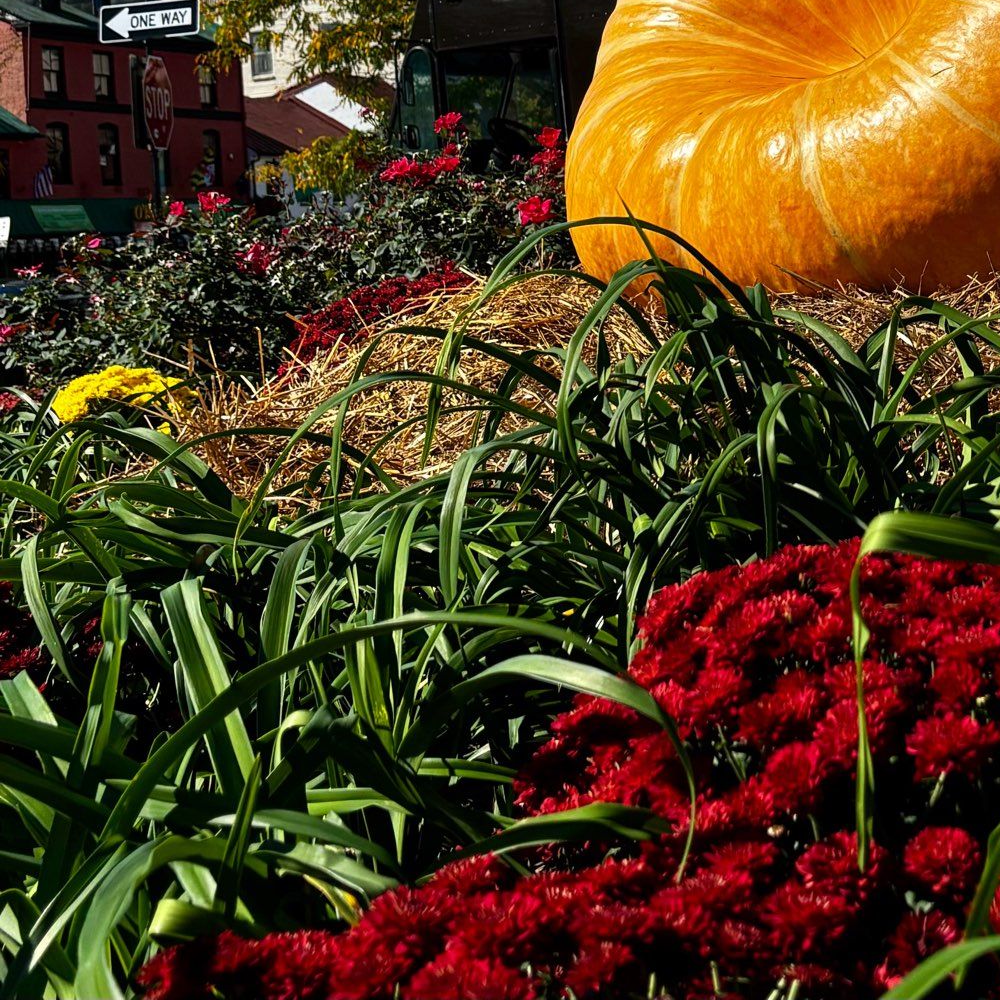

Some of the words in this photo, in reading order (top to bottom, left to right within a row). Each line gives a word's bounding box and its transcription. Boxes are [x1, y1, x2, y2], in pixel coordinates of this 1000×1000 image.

[130, 13, 157, 29] ONE
[161, 10, 188, 26] WAY
[145, 87, 171, 121] STOP
